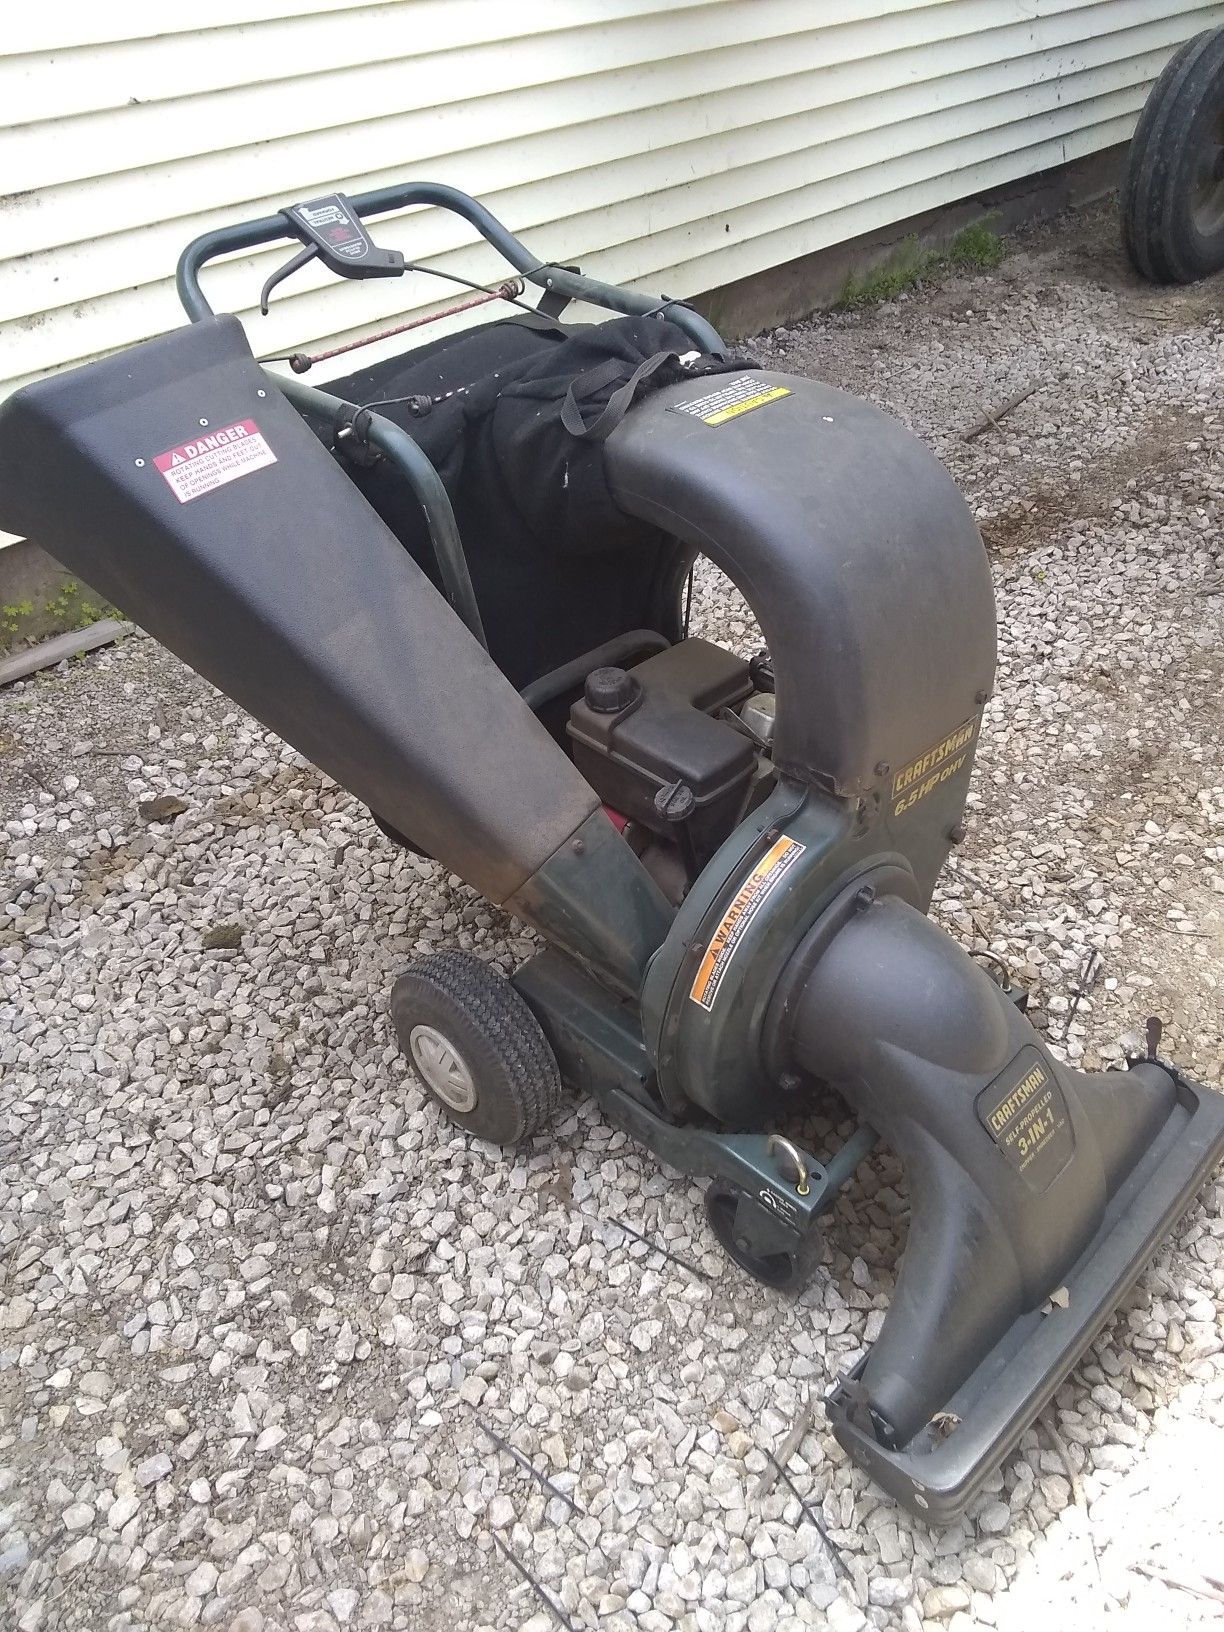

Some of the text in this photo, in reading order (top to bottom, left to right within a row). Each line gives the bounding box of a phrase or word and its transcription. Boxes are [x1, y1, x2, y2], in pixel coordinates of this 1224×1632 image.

[171, 437, 257, 477] ROTATING CUTTING BLADES
[176, 443, 262, 483] KEEP HANDS AND FEET OUT
[184, 425, 248, 458] DANGER
[191, 470, 221, 486] OPENINGS
[223, 462, 240, 472] WHILE
[242, 450, 267, 463] MACHINE
[192, 479, 220, 494] RUNNING
[896, 725, 974, 791] CRAFTSMAN
[895, 789, 919, 816] 6.5
[918, 773, 940, 800] HP
[715, 872, 763, 943] WARNING
[741, 901, 752, 915] AWAY
[714, 961, 724, 979] ATTACH
[730, 935, 737, 944] OR
[734, 914, 749, 936] OPTIONAL
[991, 1067, 1045, 1130] CRAFTSMAN
[1006, 1091, 1052, 1145] SELF-PROPELLED
[1018, 1108, 1054, 1155] 3-IN-1
